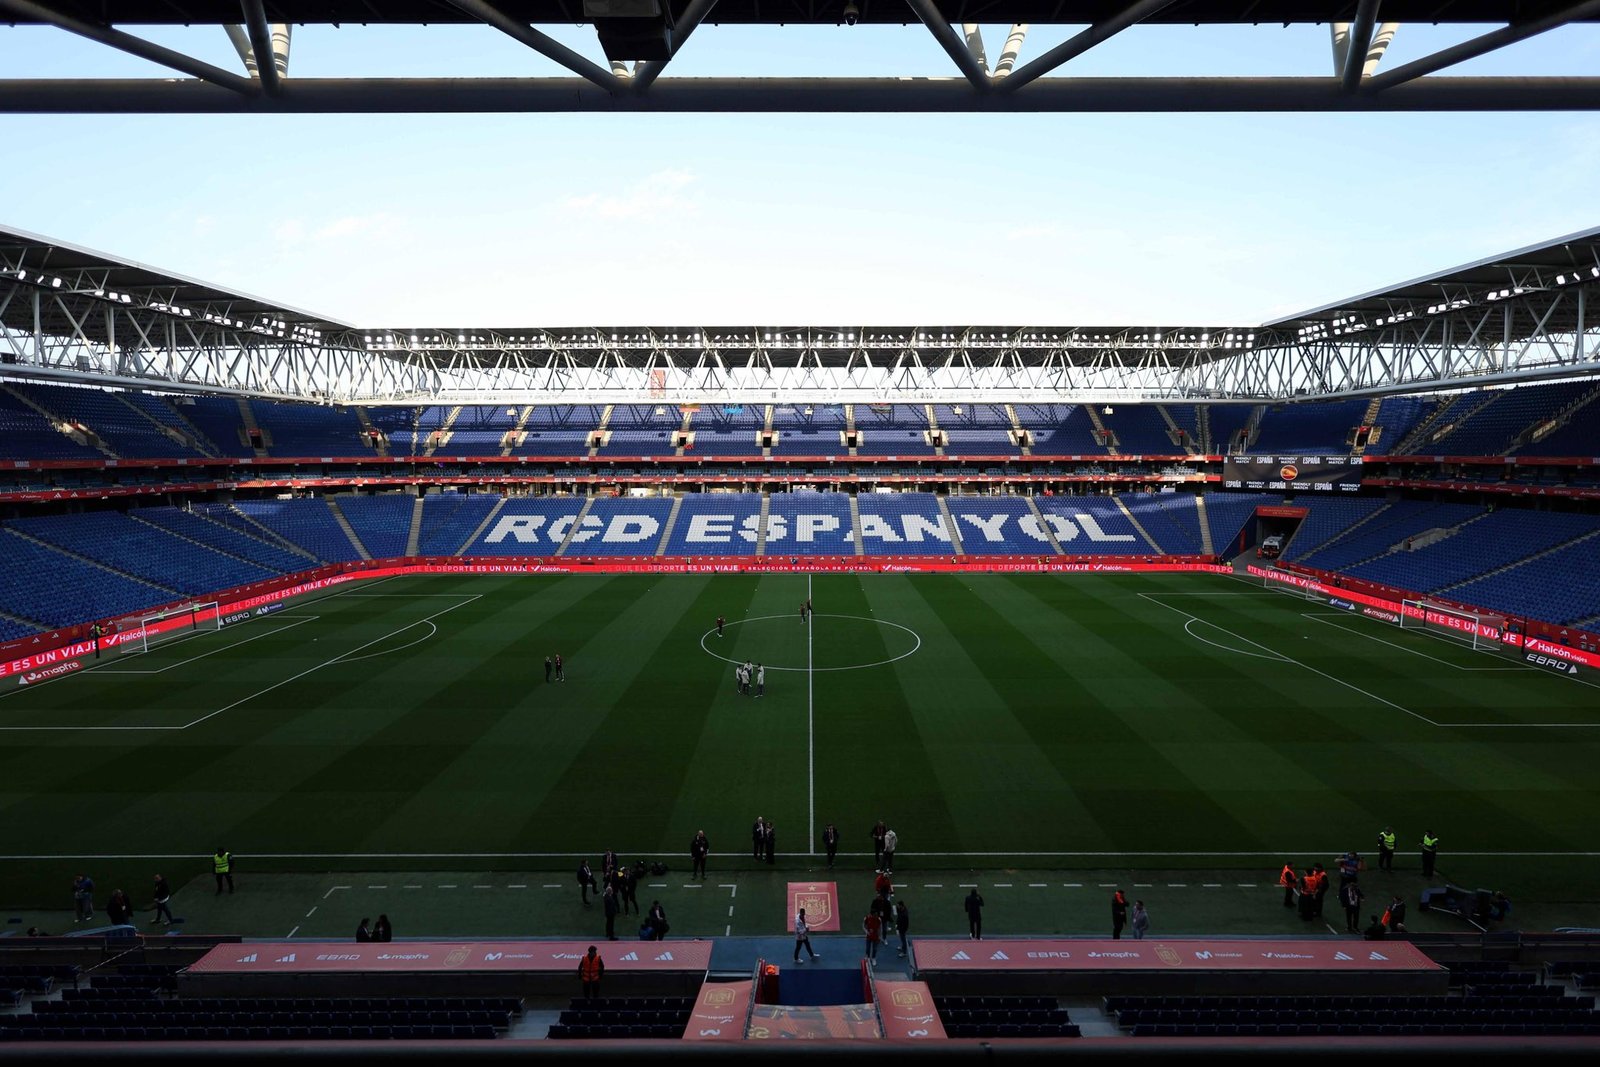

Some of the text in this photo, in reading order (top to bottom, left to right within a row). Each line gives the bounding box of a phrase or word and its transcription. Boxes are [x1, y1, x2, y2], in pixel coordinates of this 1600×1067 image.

[1257, 456, 1273, 464] ESPAÑA
[1303, 456, 1320, 464] ESPAÑA
[1226, 480, 1241, 488] ESPAÑA
[1269, 481, 1286, 489] ESPAÑA
[1314, 482, 1332, 490] ESPAÑA
[484, 514, 1136, 543] RCD ESPANYOL
[1268, 570, 1279, 578] UN
[1280, 573, 1297, 584] VIAJE
[245, 593, 279, 606] DEPORTE
[281, 589, 290, 598] ES
[292, 586, 302, 594] UN
[303, 580, 321, 591] VIAJE
[225, 612, 250, 623] EBRO
[1372, 610, 1394, 620] mapfre
[1403, 605, 1445, 624] DEPORTE
[1448, 618, 1460, 628] ES
[1464, 622, 1478, 632] UN
[119, 630, 147, 643] Halcón
[12, 659, 31, 671] ES
[36, 652, 56, 665] UN
[61, 641, 97, 658] VIAJE
[1537, 642, 1588, 664] Halcón viajes
[1526, 654, 1568, 670] EBRO
[42, 662, 79, 677] mapfre
[1102, 951, 1140, 959] mapfre
